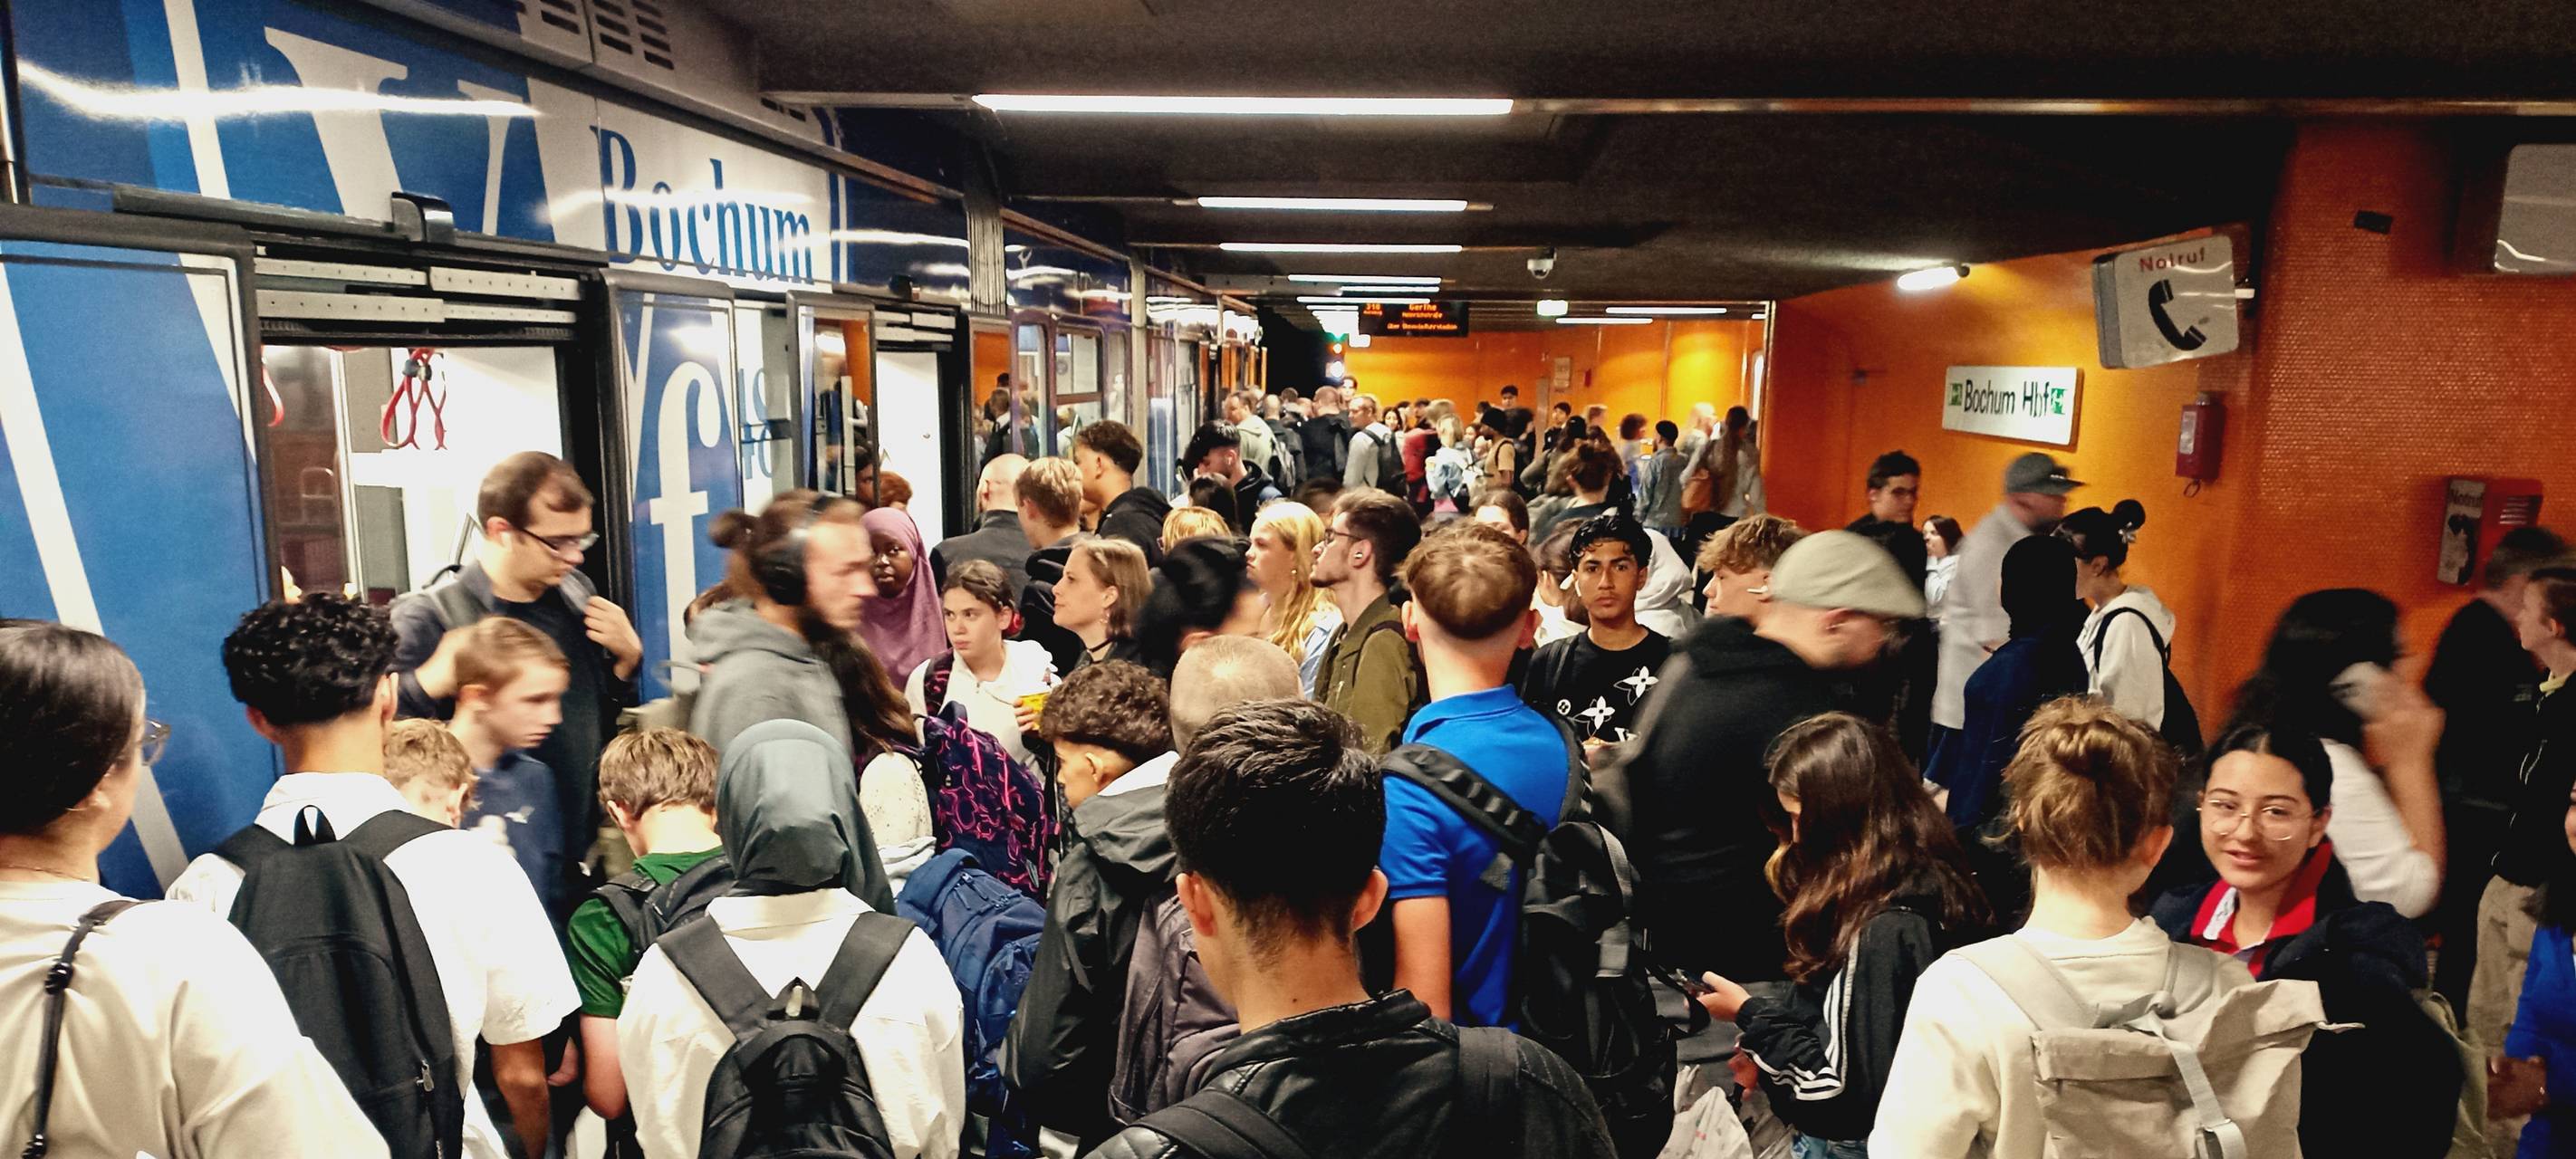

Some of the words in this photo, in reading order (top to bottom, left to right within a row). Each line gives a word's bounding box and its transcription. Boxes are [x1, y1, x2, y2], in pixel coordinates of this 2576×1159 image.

[590, 125, 814, 284] Bochum
[2139, 246, 2206, 272] Notruf
[1964, 379, 2016, 416] Bochum
[2022, 380, 2051, 418] Hbf
